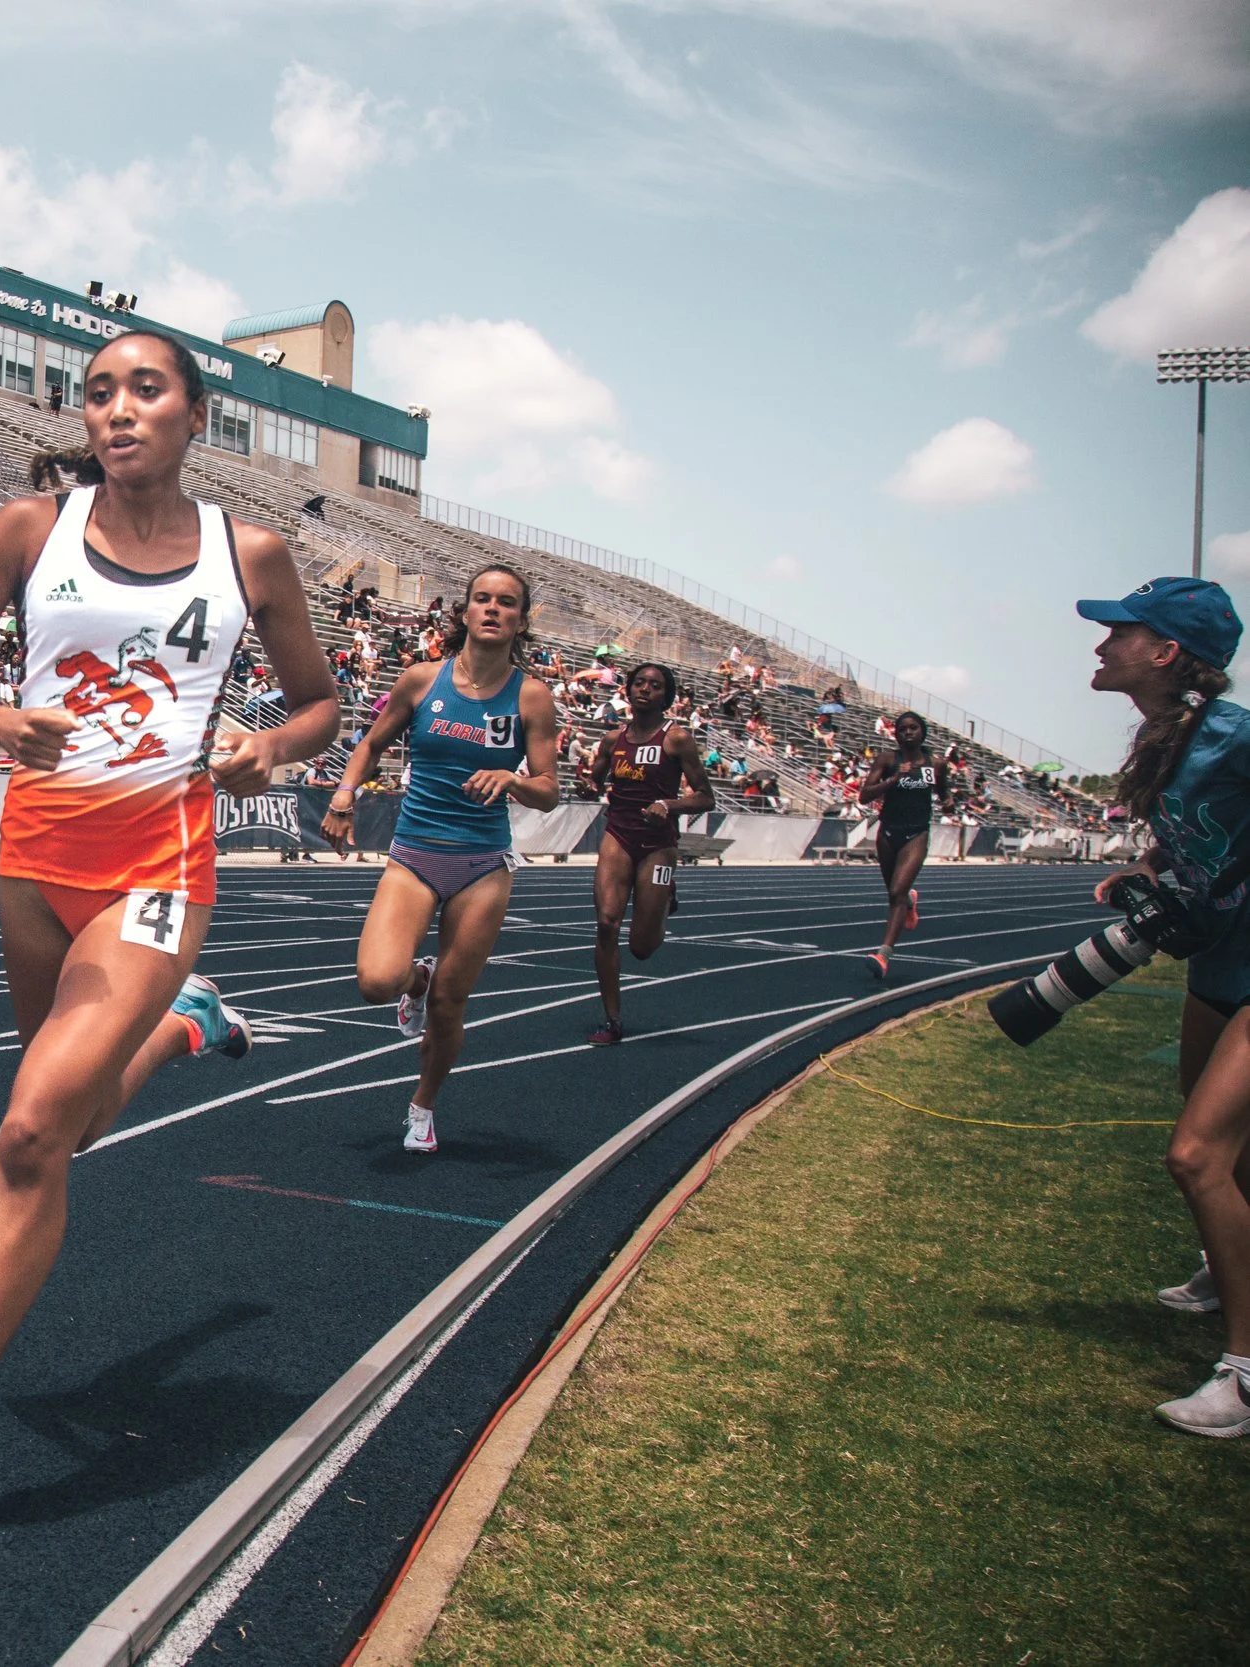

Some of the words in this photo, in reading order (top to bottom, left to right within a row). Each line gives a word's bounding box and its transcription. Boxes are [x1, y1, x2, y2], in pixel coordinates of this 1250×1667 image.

[31, 299, 47, 317] to
[46, 592, 83, 603] adidas
[166, 597, 210, 664] 4
[428, 718, 487, 745] FLORID
[491, 715, 511, 746] 9
[639, 746, 657, 763] 10
[924, 768, 933, 782] 8
[214, 794, 300, 835] OSPREYS
[655, 866, 670, 884] 10
[134, 891, 174, 945] 4
